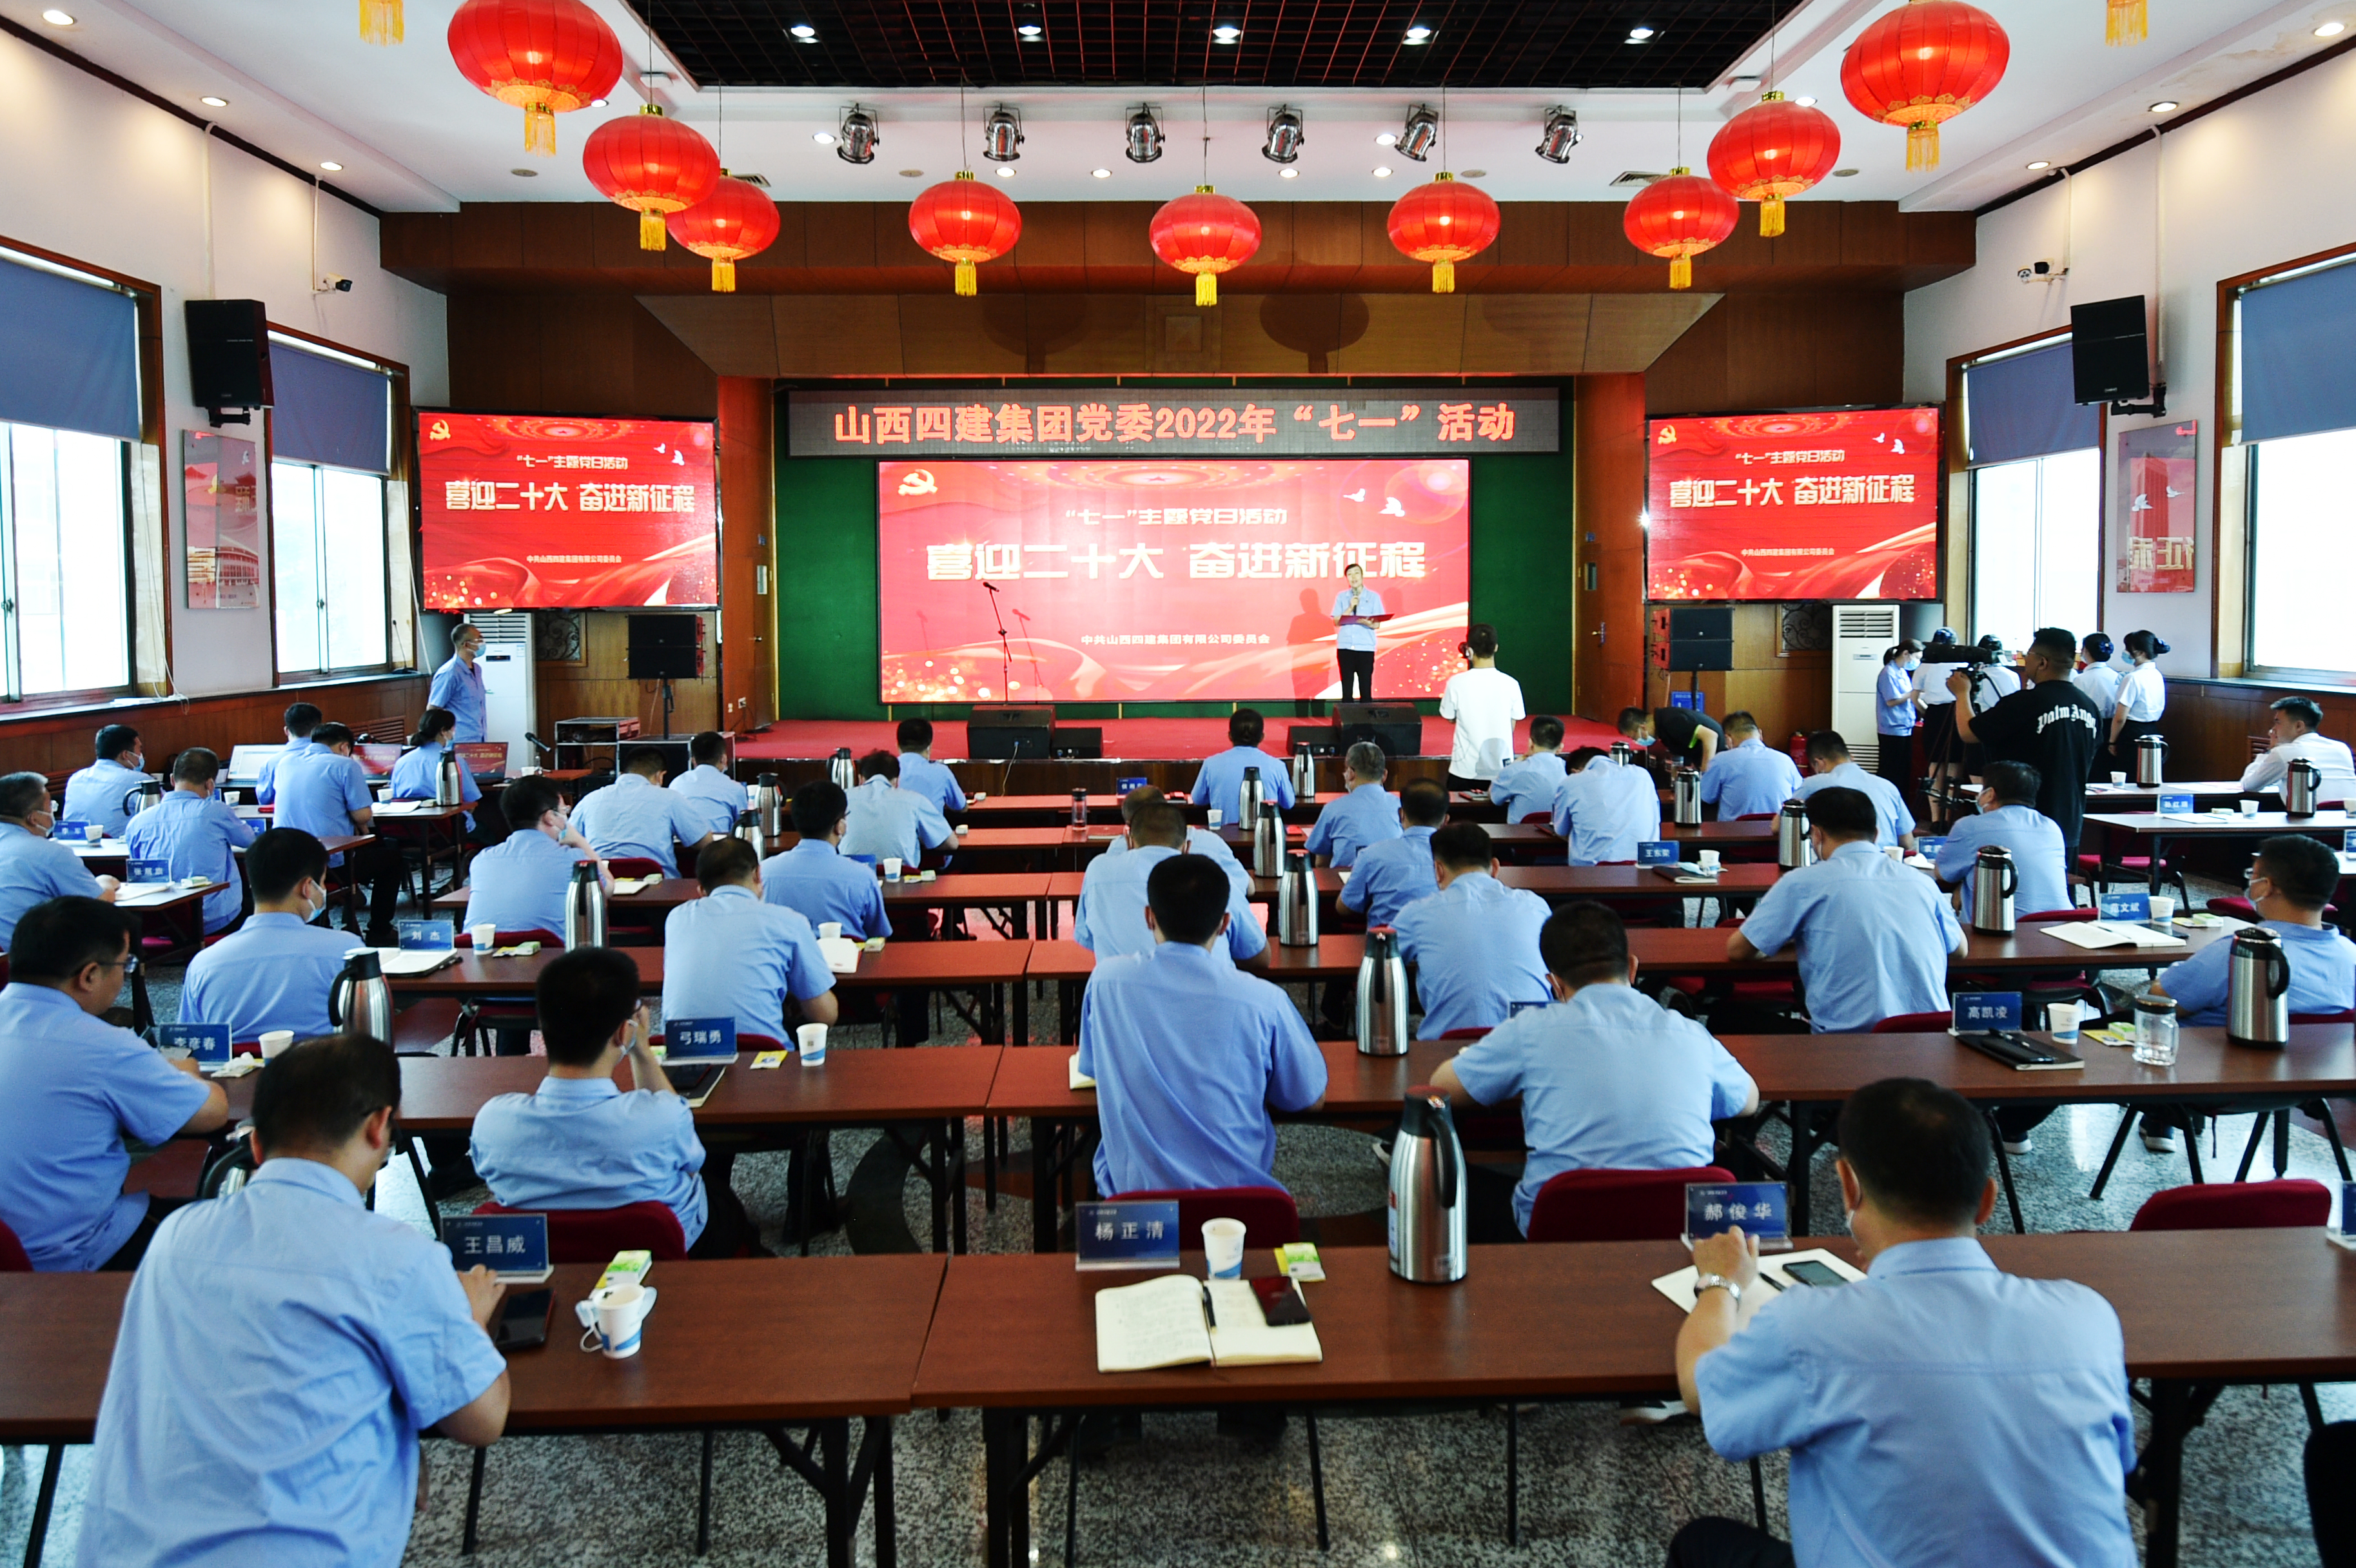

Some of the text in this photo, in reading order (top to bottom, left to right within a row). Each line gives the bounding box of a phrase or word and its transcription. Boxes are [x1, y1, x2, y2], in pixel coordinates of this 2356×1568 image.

[445, 480, 696, 513] 喜迎二十大 奋进新征程
[1669, 473, 1916, 508] 喜迎二十大 奋进新征程
[926, 542, 1426, 580] 喜迎二十大 奋进新征程
[1081, 634, 1271, 645] 中共山西四建集团有限公司委员会
[680, 1029, 722, 1045] 弓瑞勇
[1703, 1202, 1772, 1221] 郝俊华
[1095, 1220, 1164, 1240] 杨正清
[464, 1235, 526, 1254] 王昌威
